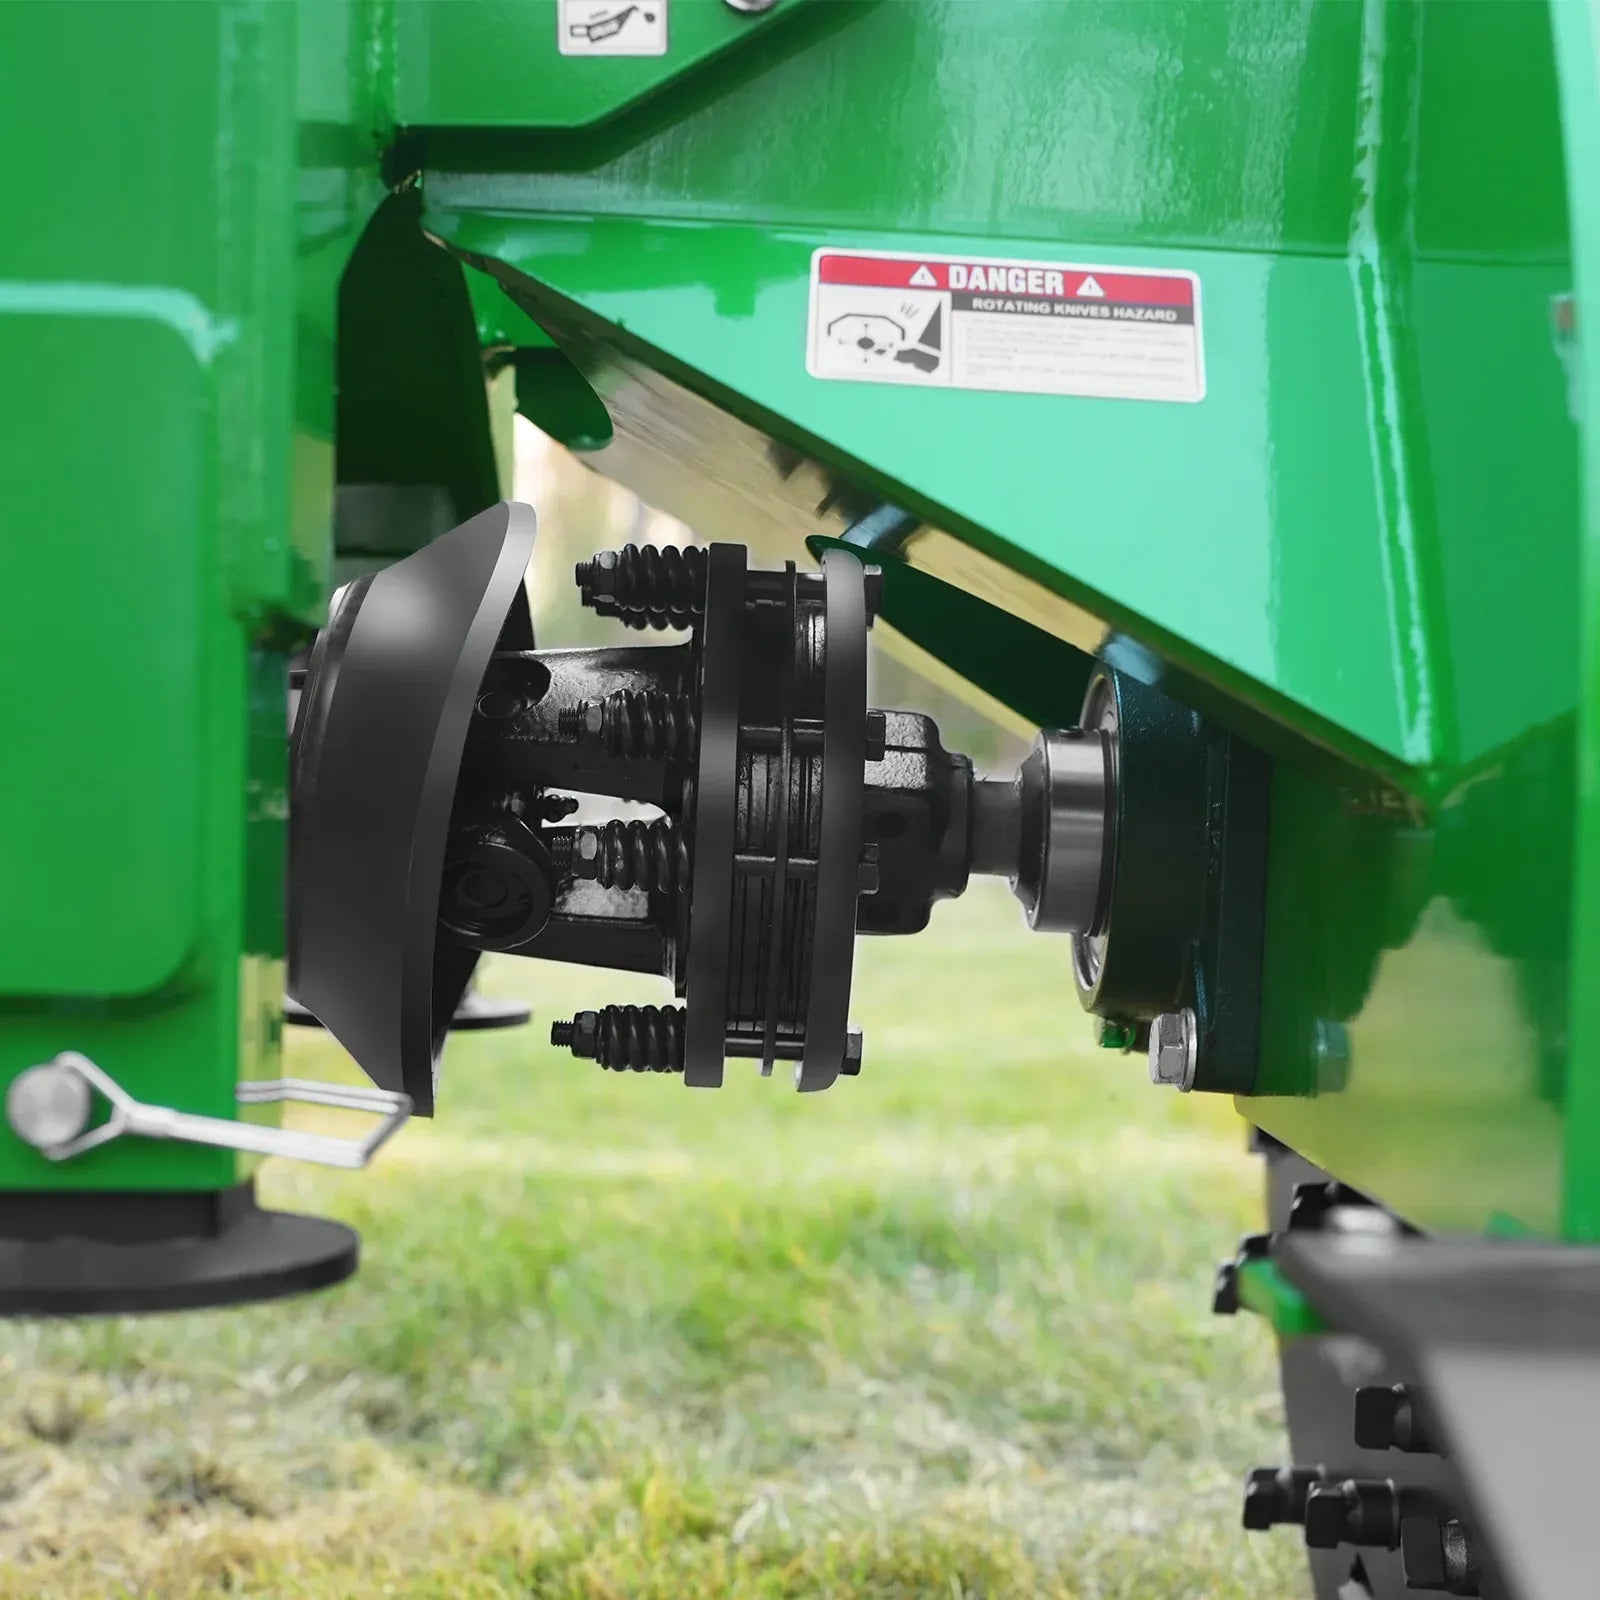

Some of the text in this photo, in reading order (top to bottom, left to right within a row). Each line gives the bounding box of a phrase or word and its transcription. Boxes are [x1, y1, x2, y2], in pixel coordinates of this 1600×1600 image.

[949, 265, 1064, 295] DANGER
[972, 298, 1177, 322] ROTATING KNIVES HAZARD
